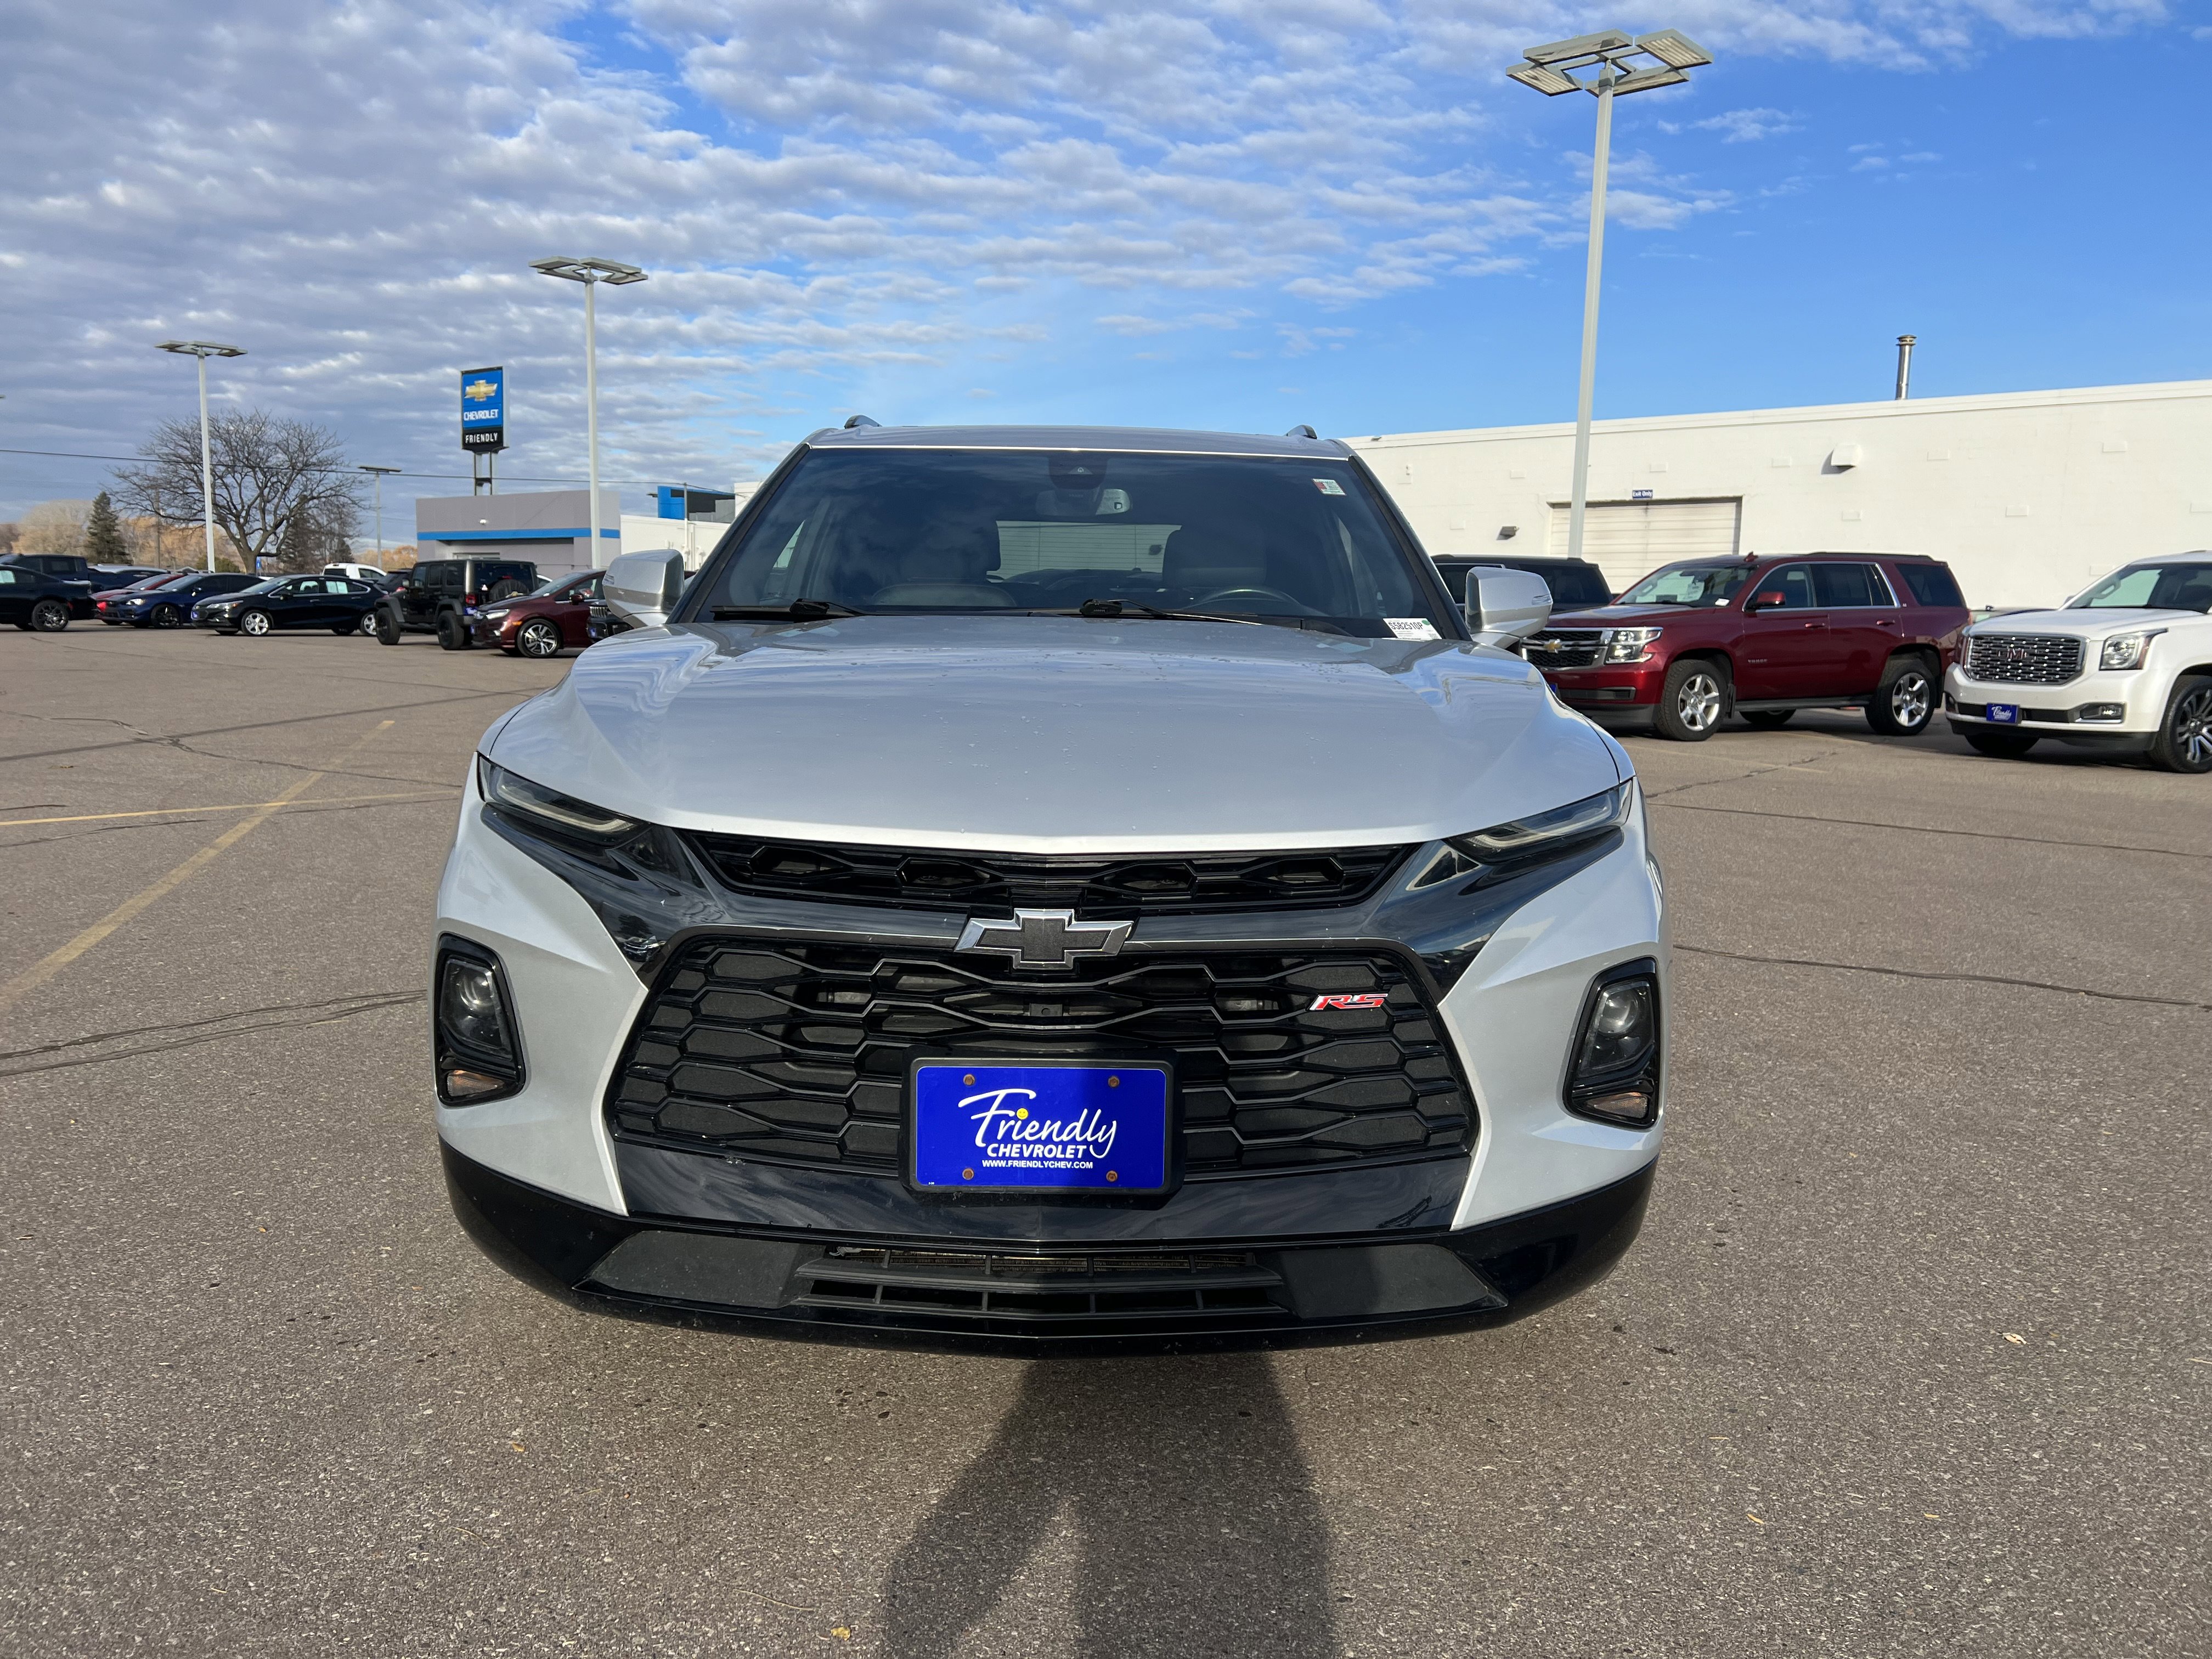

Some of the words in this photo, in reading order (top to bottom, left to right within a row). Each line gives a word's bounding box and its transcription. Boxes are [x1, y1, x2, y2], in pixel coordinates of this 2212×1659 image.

[464, 409, 499, 421] CHEVROLET
[465, 432, 498, 444] FRIENDLY
[1309, 993, 1389, 1011] RS
[958, 1088, 1116, 1159] Friendly
[987, 1143, 1087, 1158] CHEVROLET
[982, 1159, 1093, 1169] WWW.FRIENDLYCHEV.COM
